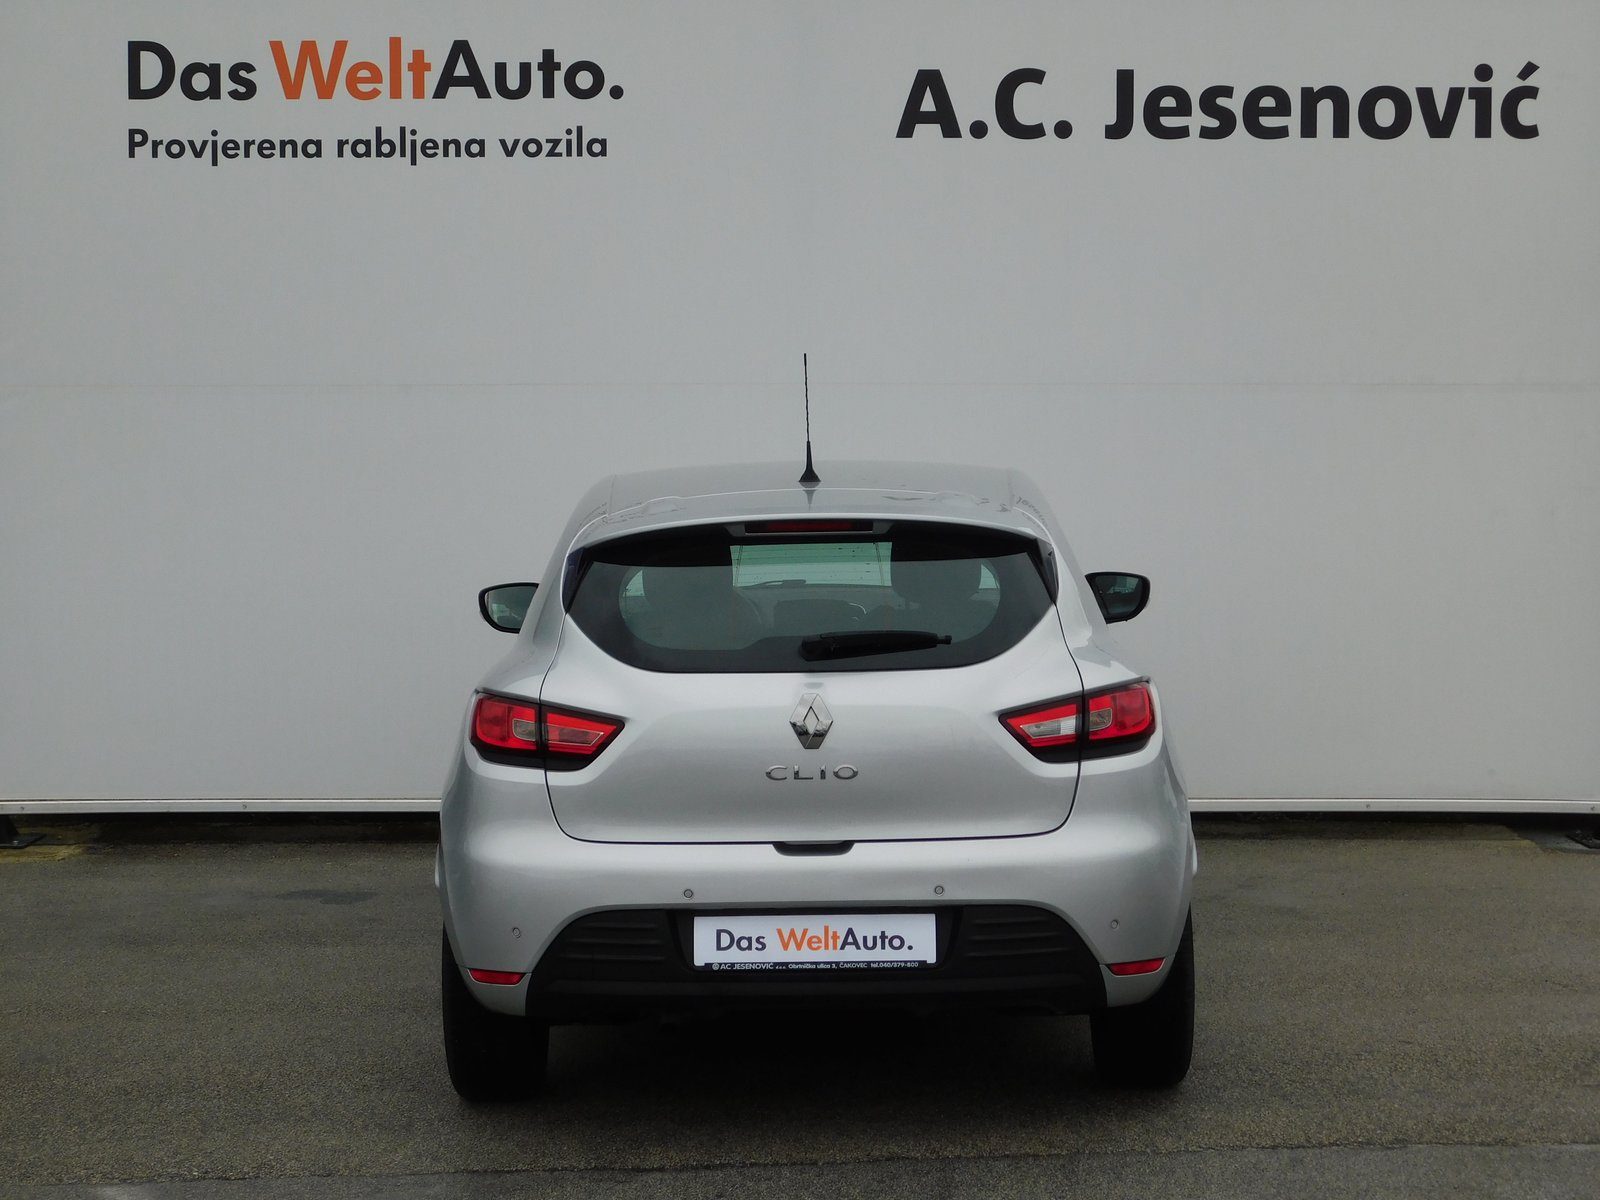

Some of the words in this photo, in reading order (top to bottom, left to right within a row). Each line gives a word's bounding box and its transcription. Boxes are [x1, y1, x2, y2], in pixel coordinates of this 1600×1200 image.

[128, 40, 258, 101] Das
[269, 37, 624, 101] WeltAuto.
[896, 68, 1073, 140] A.C.
[1105, 61, 1540, 140] Jesenović
[128, 128, 323, 167] Provjerena
[337, 126, 486, 167] rabljena
[499, 125, 608, 158] vozila
[765, 764, 859, 781] CLIO
[716, 928, 767, 951] Das
[776, 925, 914, 952] WeltAuto.
[733, 962, 774, 970] JESENOVIĆ
